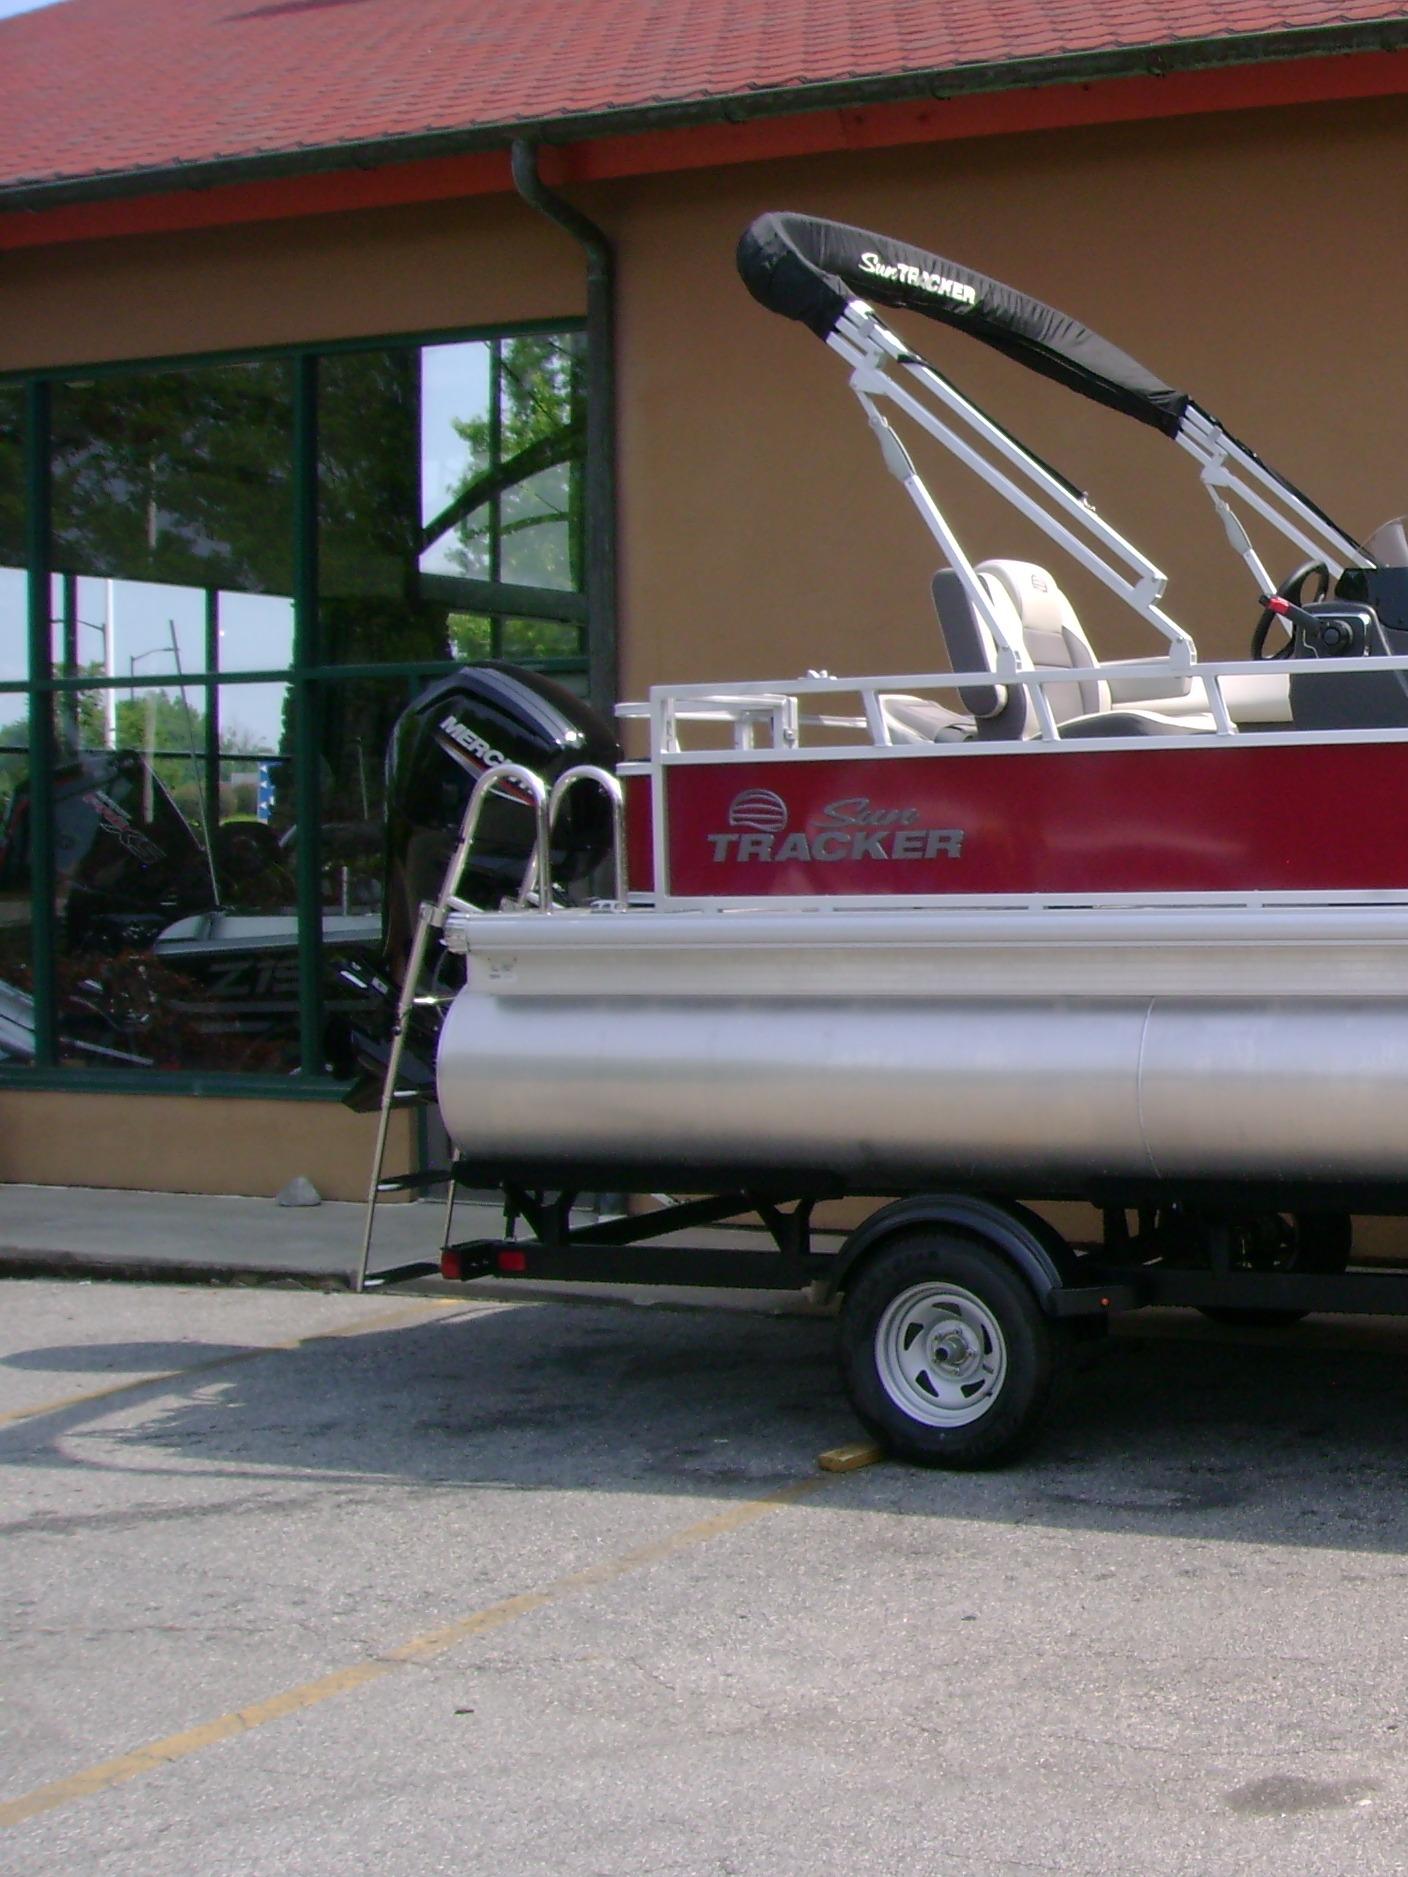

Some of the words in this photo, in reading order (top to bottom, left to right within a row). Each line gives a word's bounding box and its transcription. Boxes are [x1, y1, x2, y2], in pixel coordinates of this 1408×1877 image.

[858, 252, 899, 280] Sun
[897, 263, 977, 305] TRACKER
[440, 715, 540, 796] MERC
[811, 797, 920, 828] Sun
[707, 829, 965, 863] TRACKER
